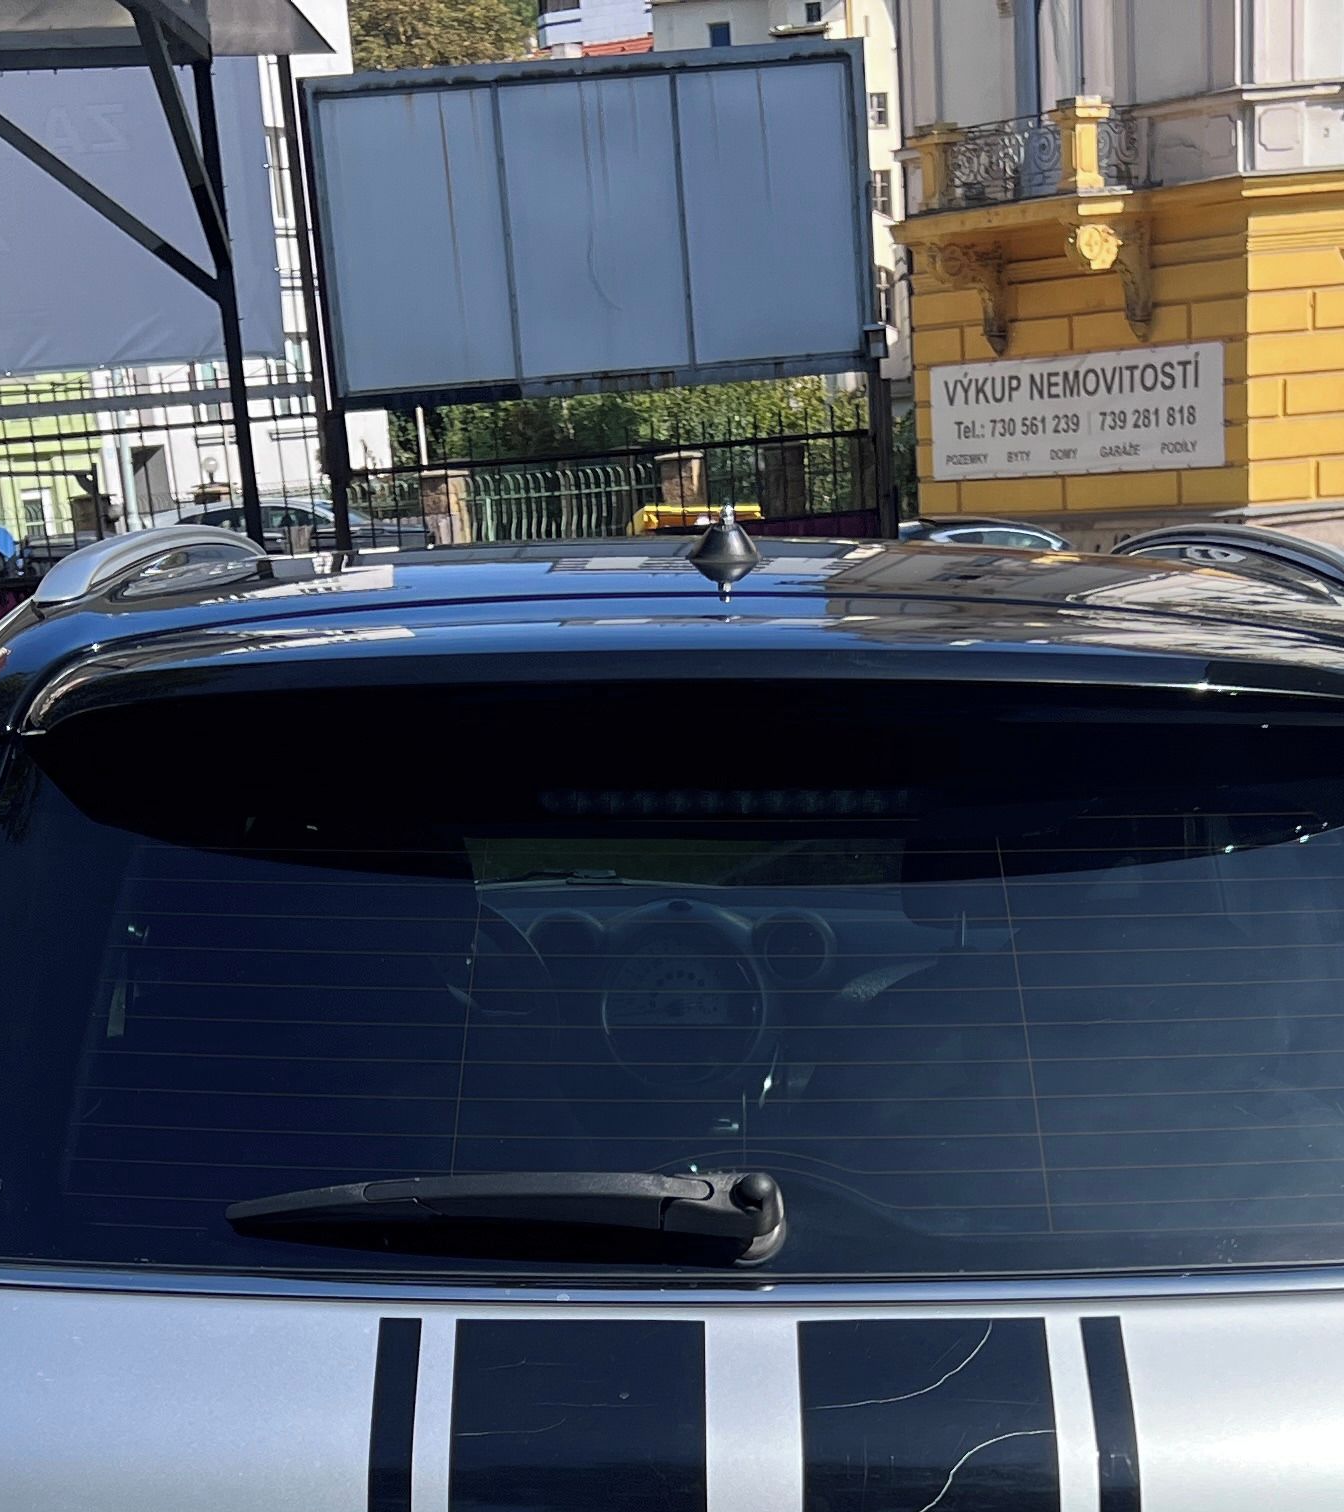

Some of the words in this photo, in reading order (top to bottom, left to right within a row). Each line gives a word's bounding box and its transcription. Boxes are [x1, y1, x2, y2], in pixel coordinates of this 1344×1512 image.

[944, 371, 1021, 406] VÝKUP
[1029, 352, 1200, 401] NEMOVITOSTÍ
[955, 420, 985, 440] Tel.:
[989, 418, 1016, 437] 730
[1021, 415, 1047, 435] 561
[1052, 414, 1080, 434] 239
[1099, 411, 1127, 431] 739
[1132, 408, 1160, 428] 281
[1166, 405, 1196, 426] 818
[945, 452, 989, 466] POZEMKY
[1006, 450, 1032, 463] BYTY
[1049, 448, 1079, 461] DOMY
